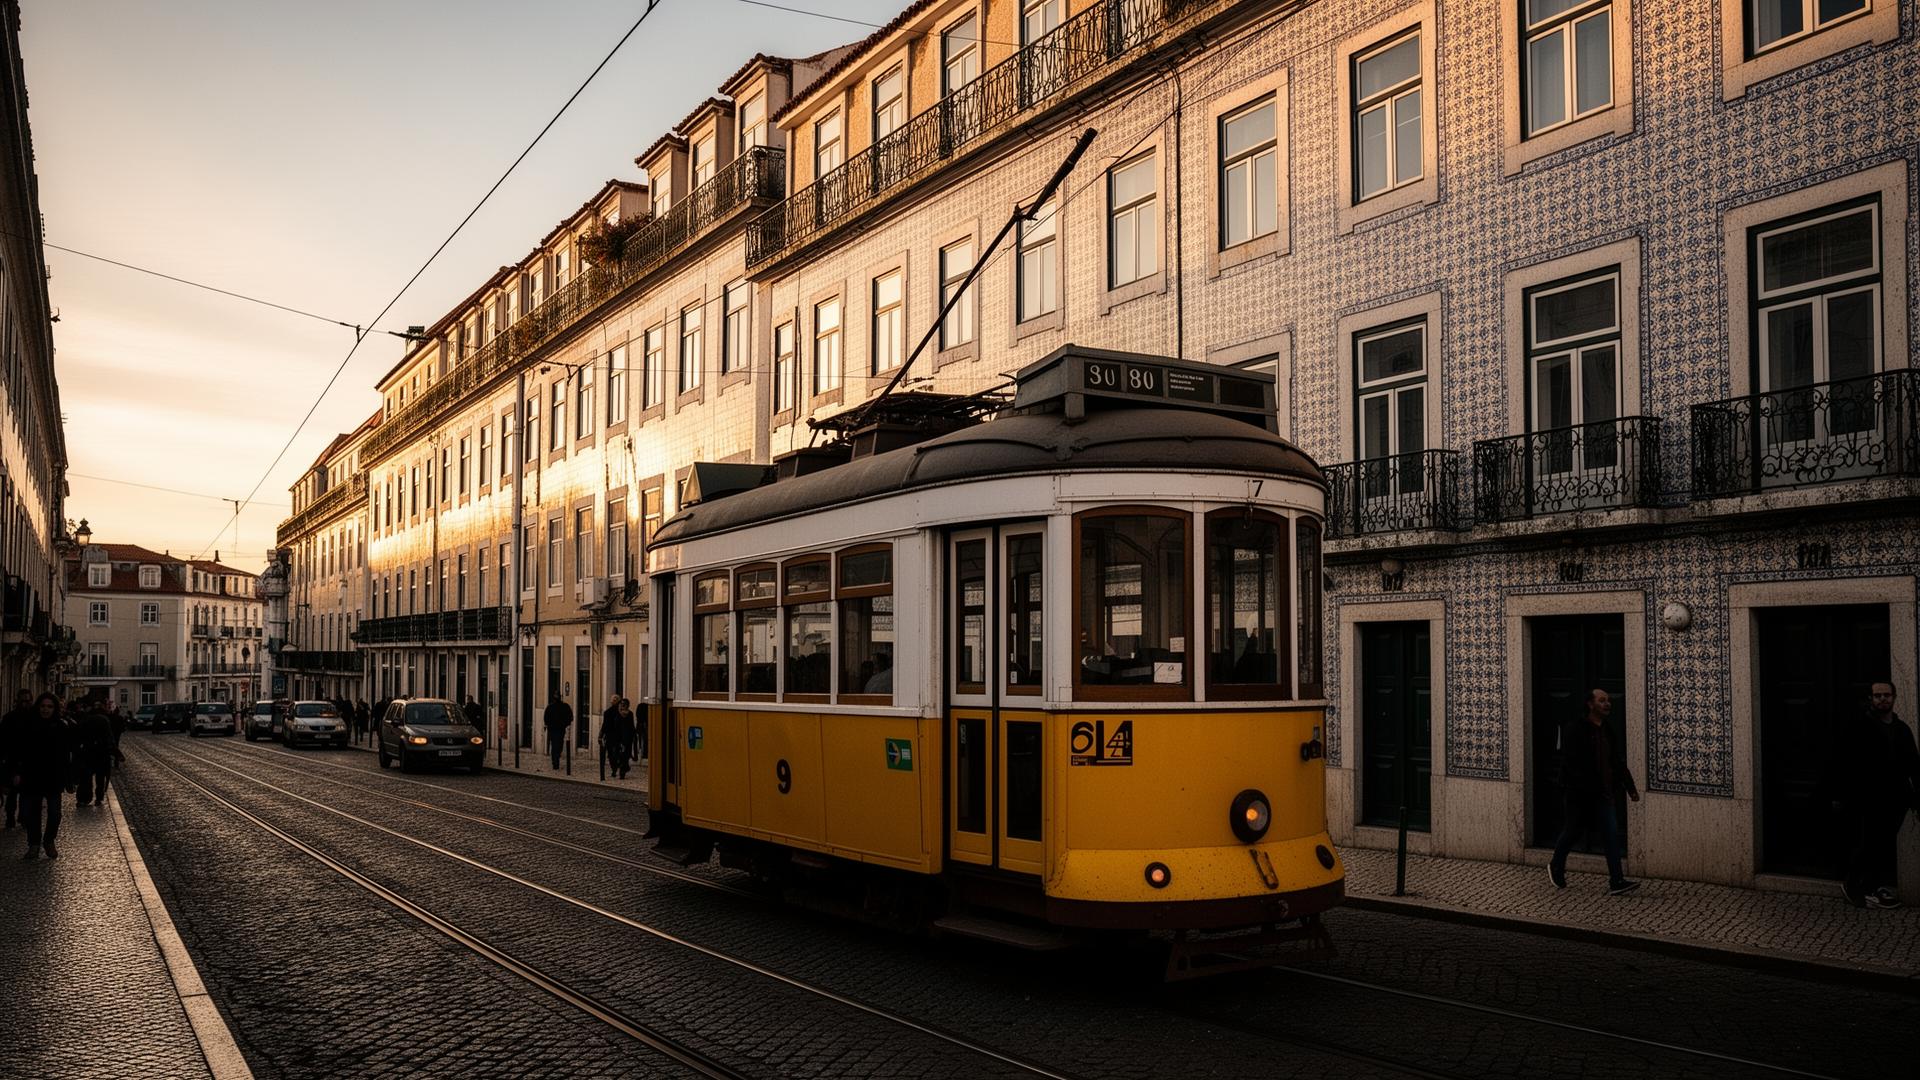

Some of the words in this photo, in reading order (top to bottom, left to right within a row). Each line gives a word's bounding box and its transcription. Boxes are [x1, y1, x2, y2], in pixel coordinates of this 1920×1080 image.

[1129, 368, 1154, 390] 80
[1252, 479, 1264, 497] 7
[776, 758, 792, 795] 9
